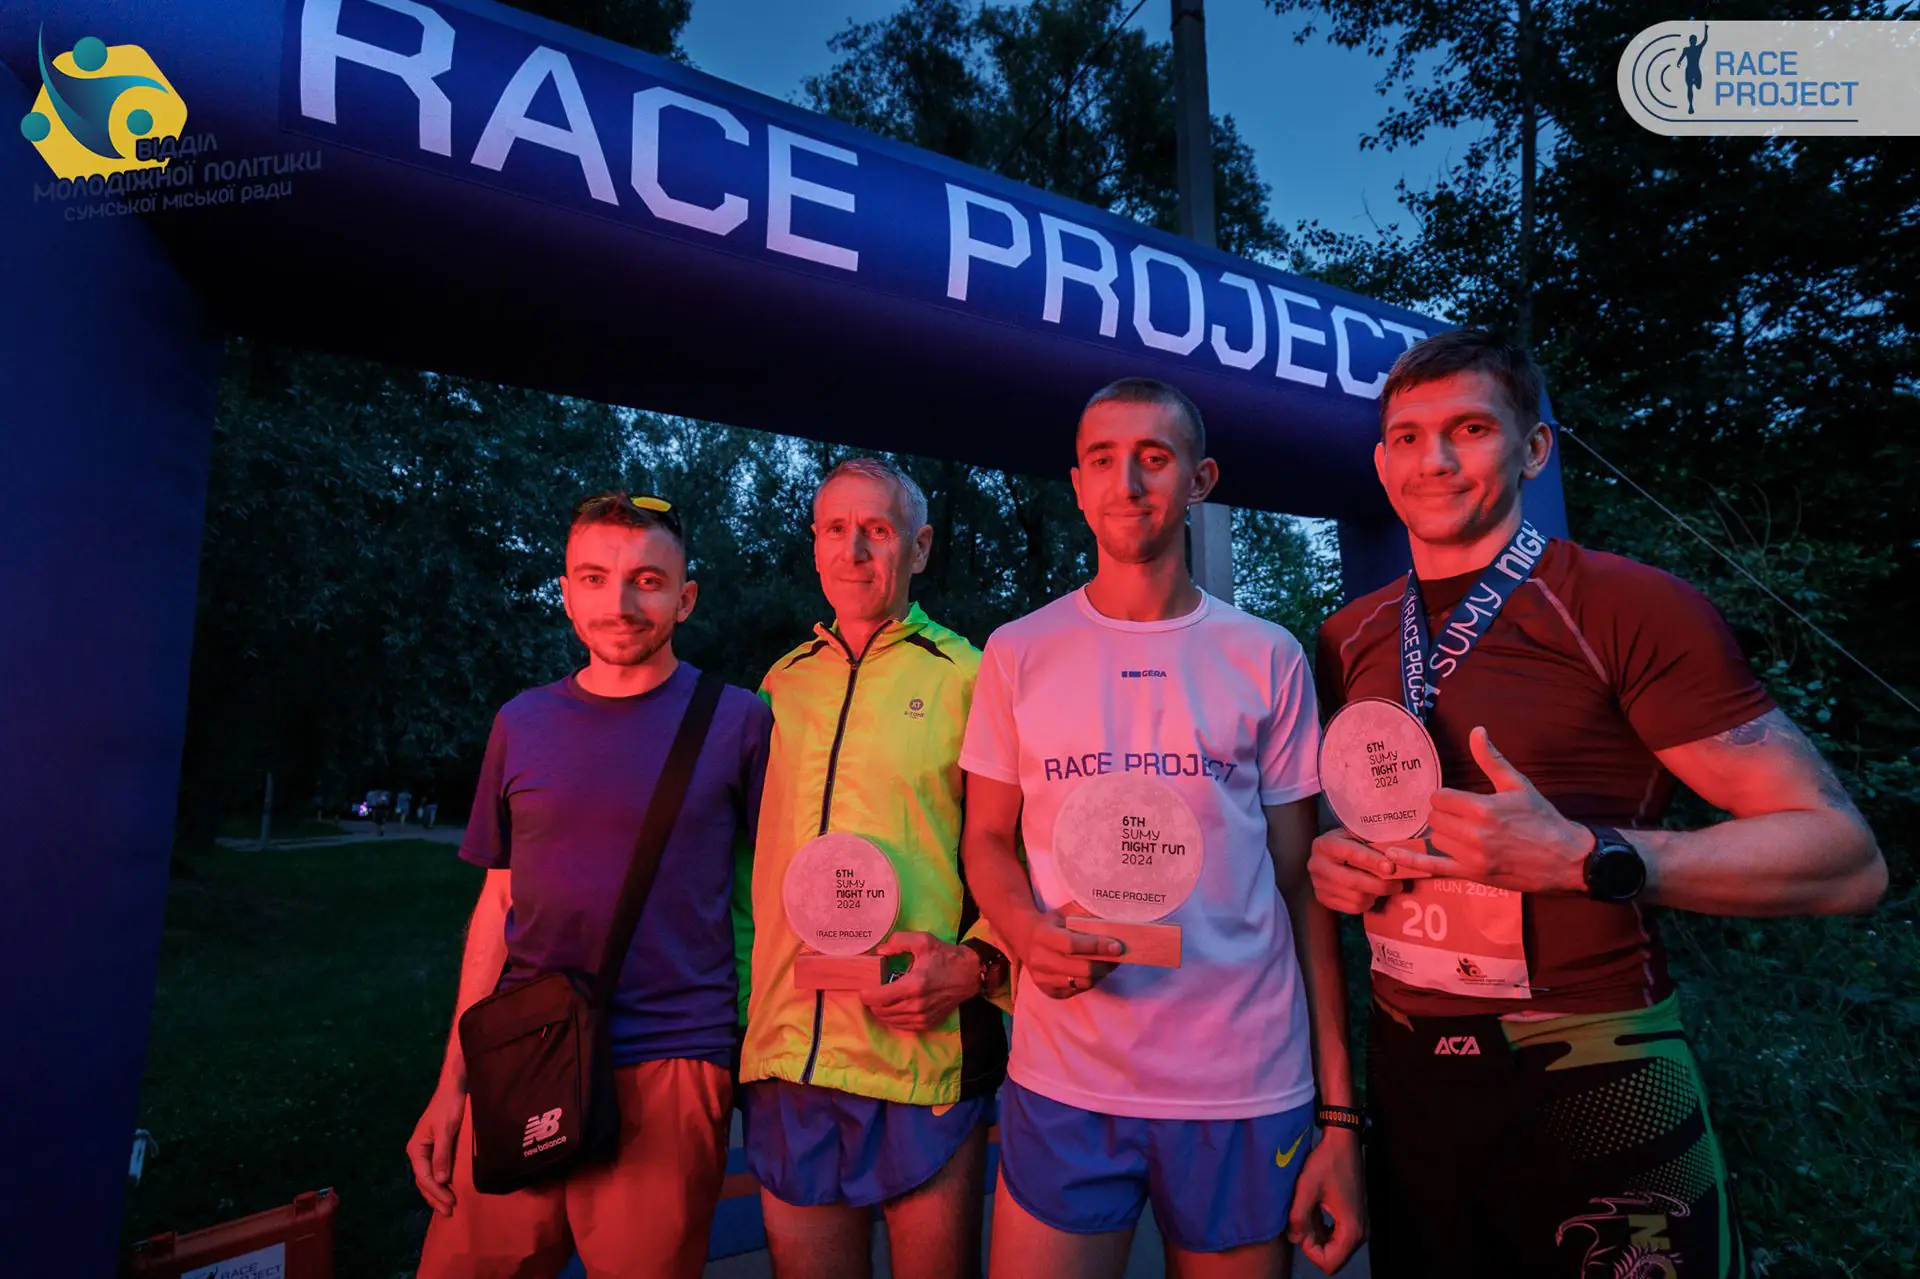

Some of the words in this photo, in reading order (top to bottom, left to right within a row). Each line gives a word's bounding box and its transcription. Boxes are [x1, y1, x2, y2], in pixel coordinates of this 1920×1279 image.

[300, 0, 859, 272] RACE
[1403, 605, 1420, 651] RACE
[1367, 741, 1385, 753] 6TH
[1044, 752, 1113, 781] RACE
[1125, 753, 1237, 783] PROJECT
[1374, 775, 1399, 789] 2024
[1122, 816, 1146, 827] 6TH
[1363, 815, 1382, 824] RACE
[1383, 810, 1416, 821] PROJECT
[1121, 853, 1153, 866] 2024
[835, 869, 854, 878] 6TH
[1095, 889, 1121, 899] RACE
[1122, 891, 1166, 903] PROJECT
[1433, 879, 1463, 895] RUN
[1466, 880, 1510, 899] 2024
[836, 899, 861, 909] 2024
[1402, 899, 1448, 942] 20
[818, 930, 838, 938] RACE
[839, 930, 873, 938] PROJECT
[537, 1135, 567, 1152] balance
